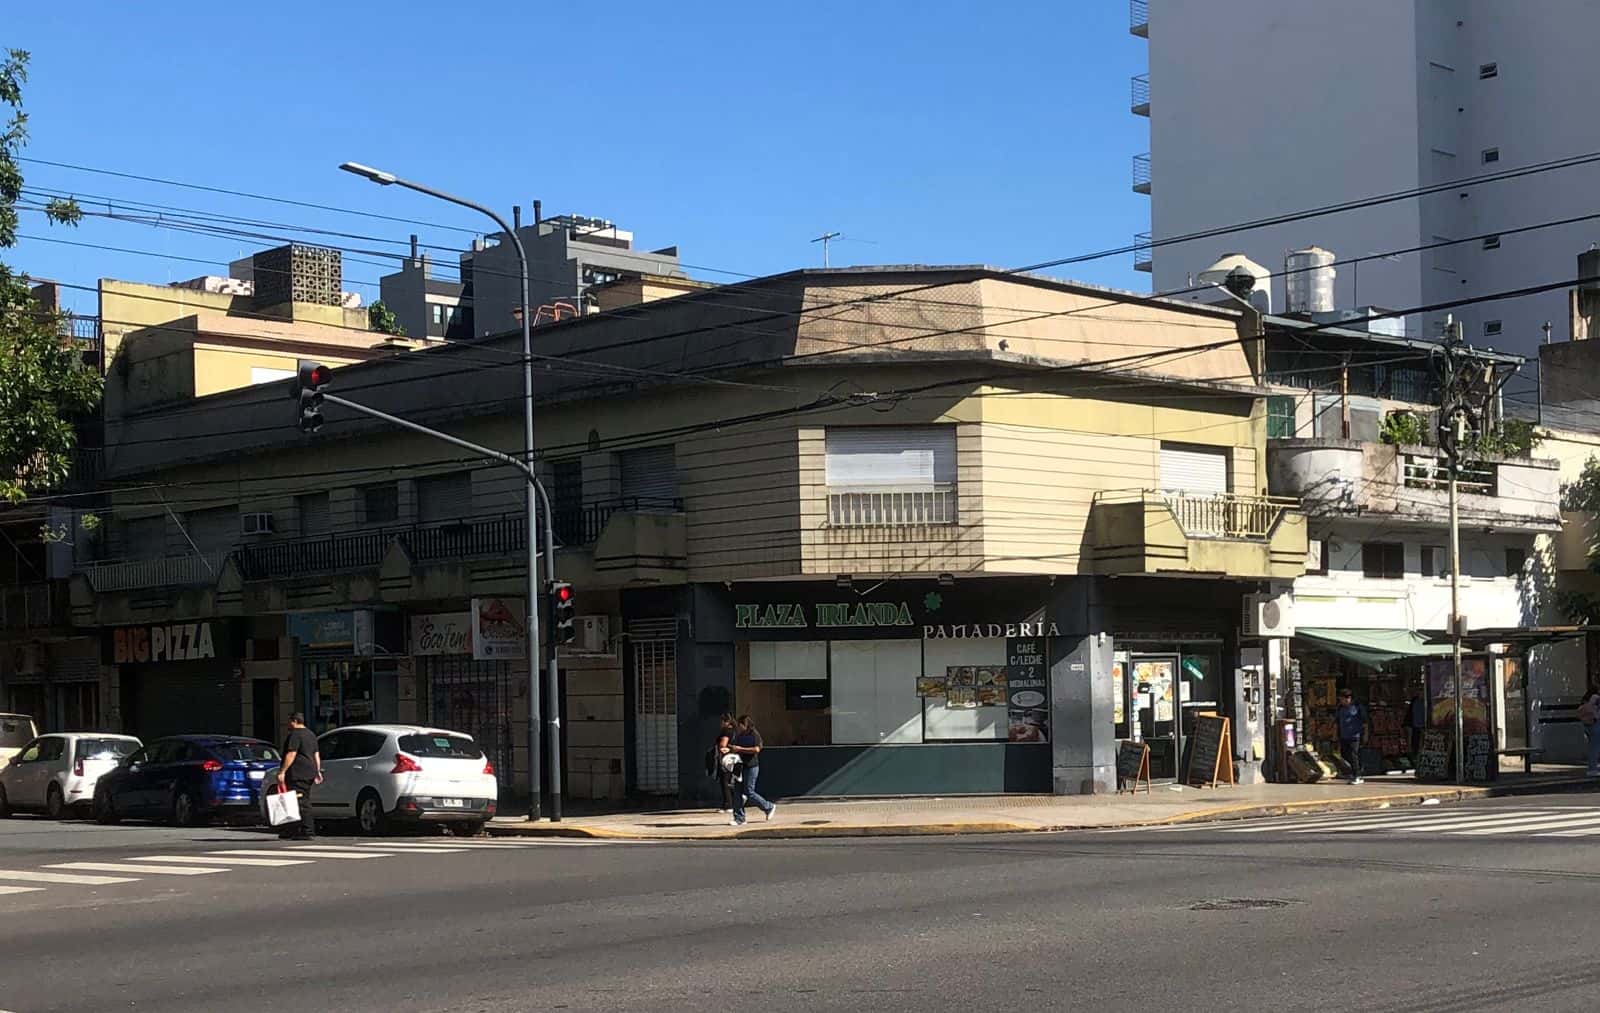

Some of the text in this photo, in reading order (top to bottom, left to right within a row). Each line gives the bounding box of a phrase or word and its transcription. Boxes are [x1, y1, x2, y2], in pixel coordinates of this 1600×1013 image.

[735, 601, 915, 628] PLAZA IRLANDA
[922, 617, 1062, 640] PANADERÍA
[112, 622, 216, 664] BIG PIZZA
[1016, 641, 1036, 654] CAFÉ
[1010, 655, 1042, 666] C/LECHE
[1028, 667, 1035, 678] 2
